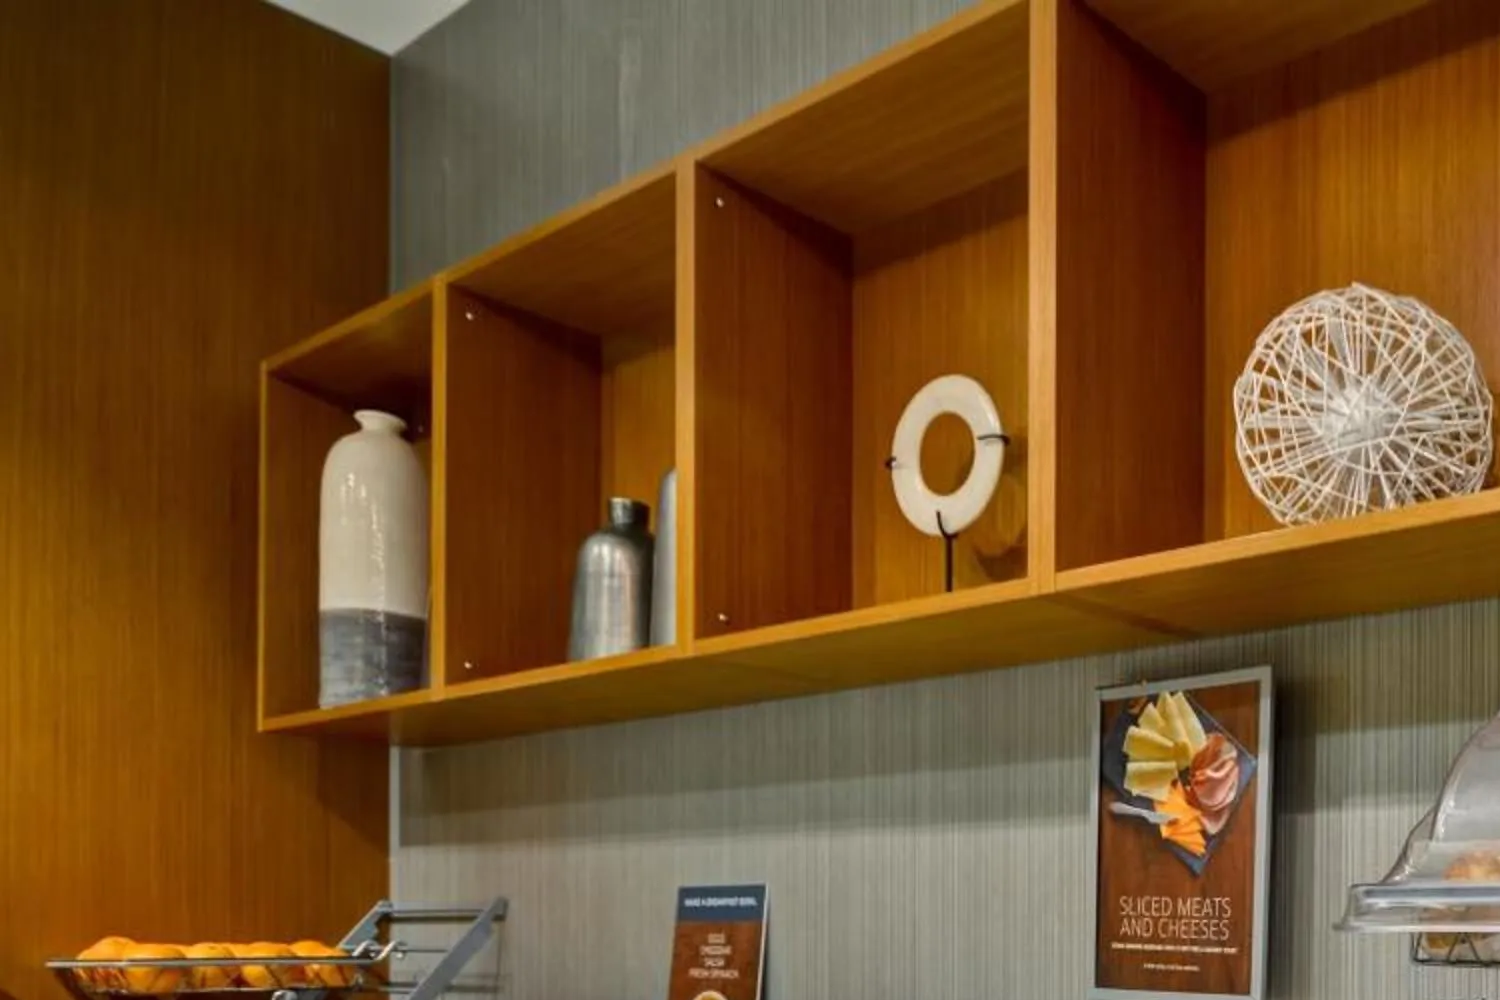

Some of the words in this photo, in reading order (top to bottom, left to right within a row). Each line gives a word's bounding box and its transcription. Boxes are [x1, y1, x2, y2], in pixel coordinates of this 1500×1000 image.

[1119, 896, 1173, 918] SLICED
[1177, 897, 1232, 919] MEATS
[1119, 918, 1154, 938] AND
[1157, 919, 1230, 941] CHEESES
